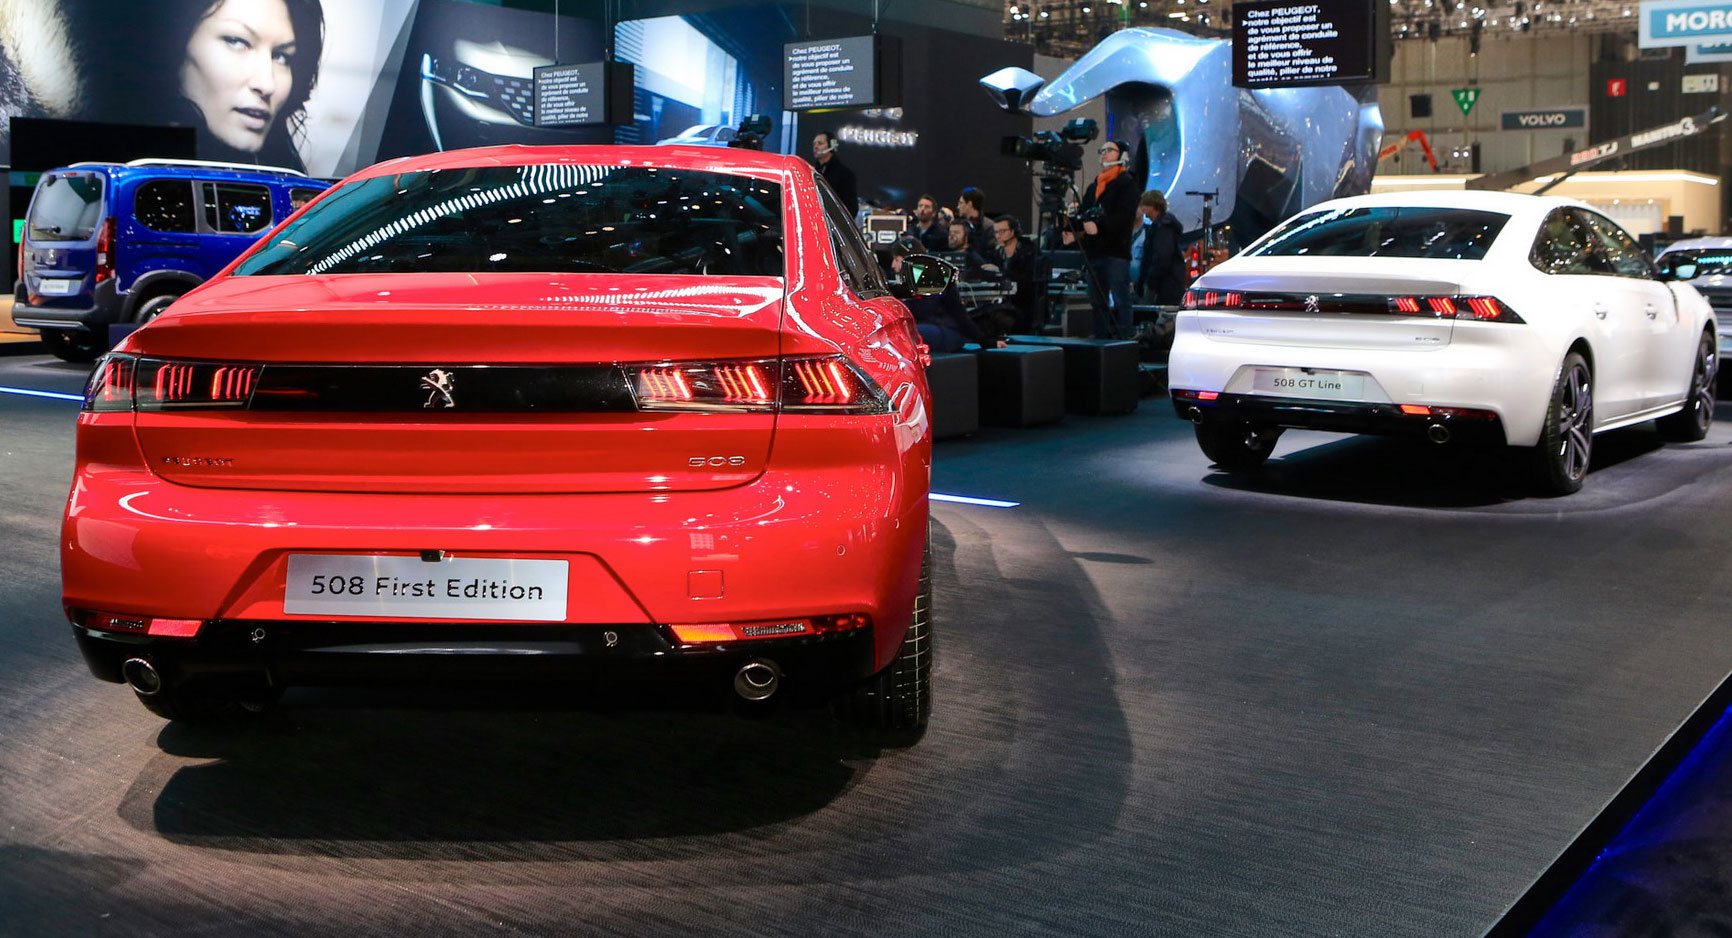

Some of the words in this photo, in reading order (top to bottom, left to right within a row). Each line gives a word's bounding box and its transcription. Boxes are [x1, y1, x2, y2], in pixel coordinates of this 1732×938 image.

[1271, 15, 1301, 25] objectif
[1248, 27, 1258, 35] de
[1282, 23, 1319, 33] proposer
[1248, 34, 1287, 44] agrément
[1301, 30, 1338, 39] conduite
[1292, 48, 1312, 57] offrir
[1258, 59, 1290, 68] meilleur
[1292, 57, 1320, 66] niveau
[1322, 56, 1333, 64] de
[1280, 67, 1300, 76] pilier
[1315, 65, 1337, 73] notre
[1519, 113, 1566, 126] VOLVO
[1274, 378, 1294, 387] 508
[1298, 380, 1315, 388] GT
[1318, 380, 1341, 390] Line
[688, 456, 745, 466] 508
[312, 576, 364, 595] 508
[376, 577, 436, 597] First
[446, 579, 543, 600] Edition
